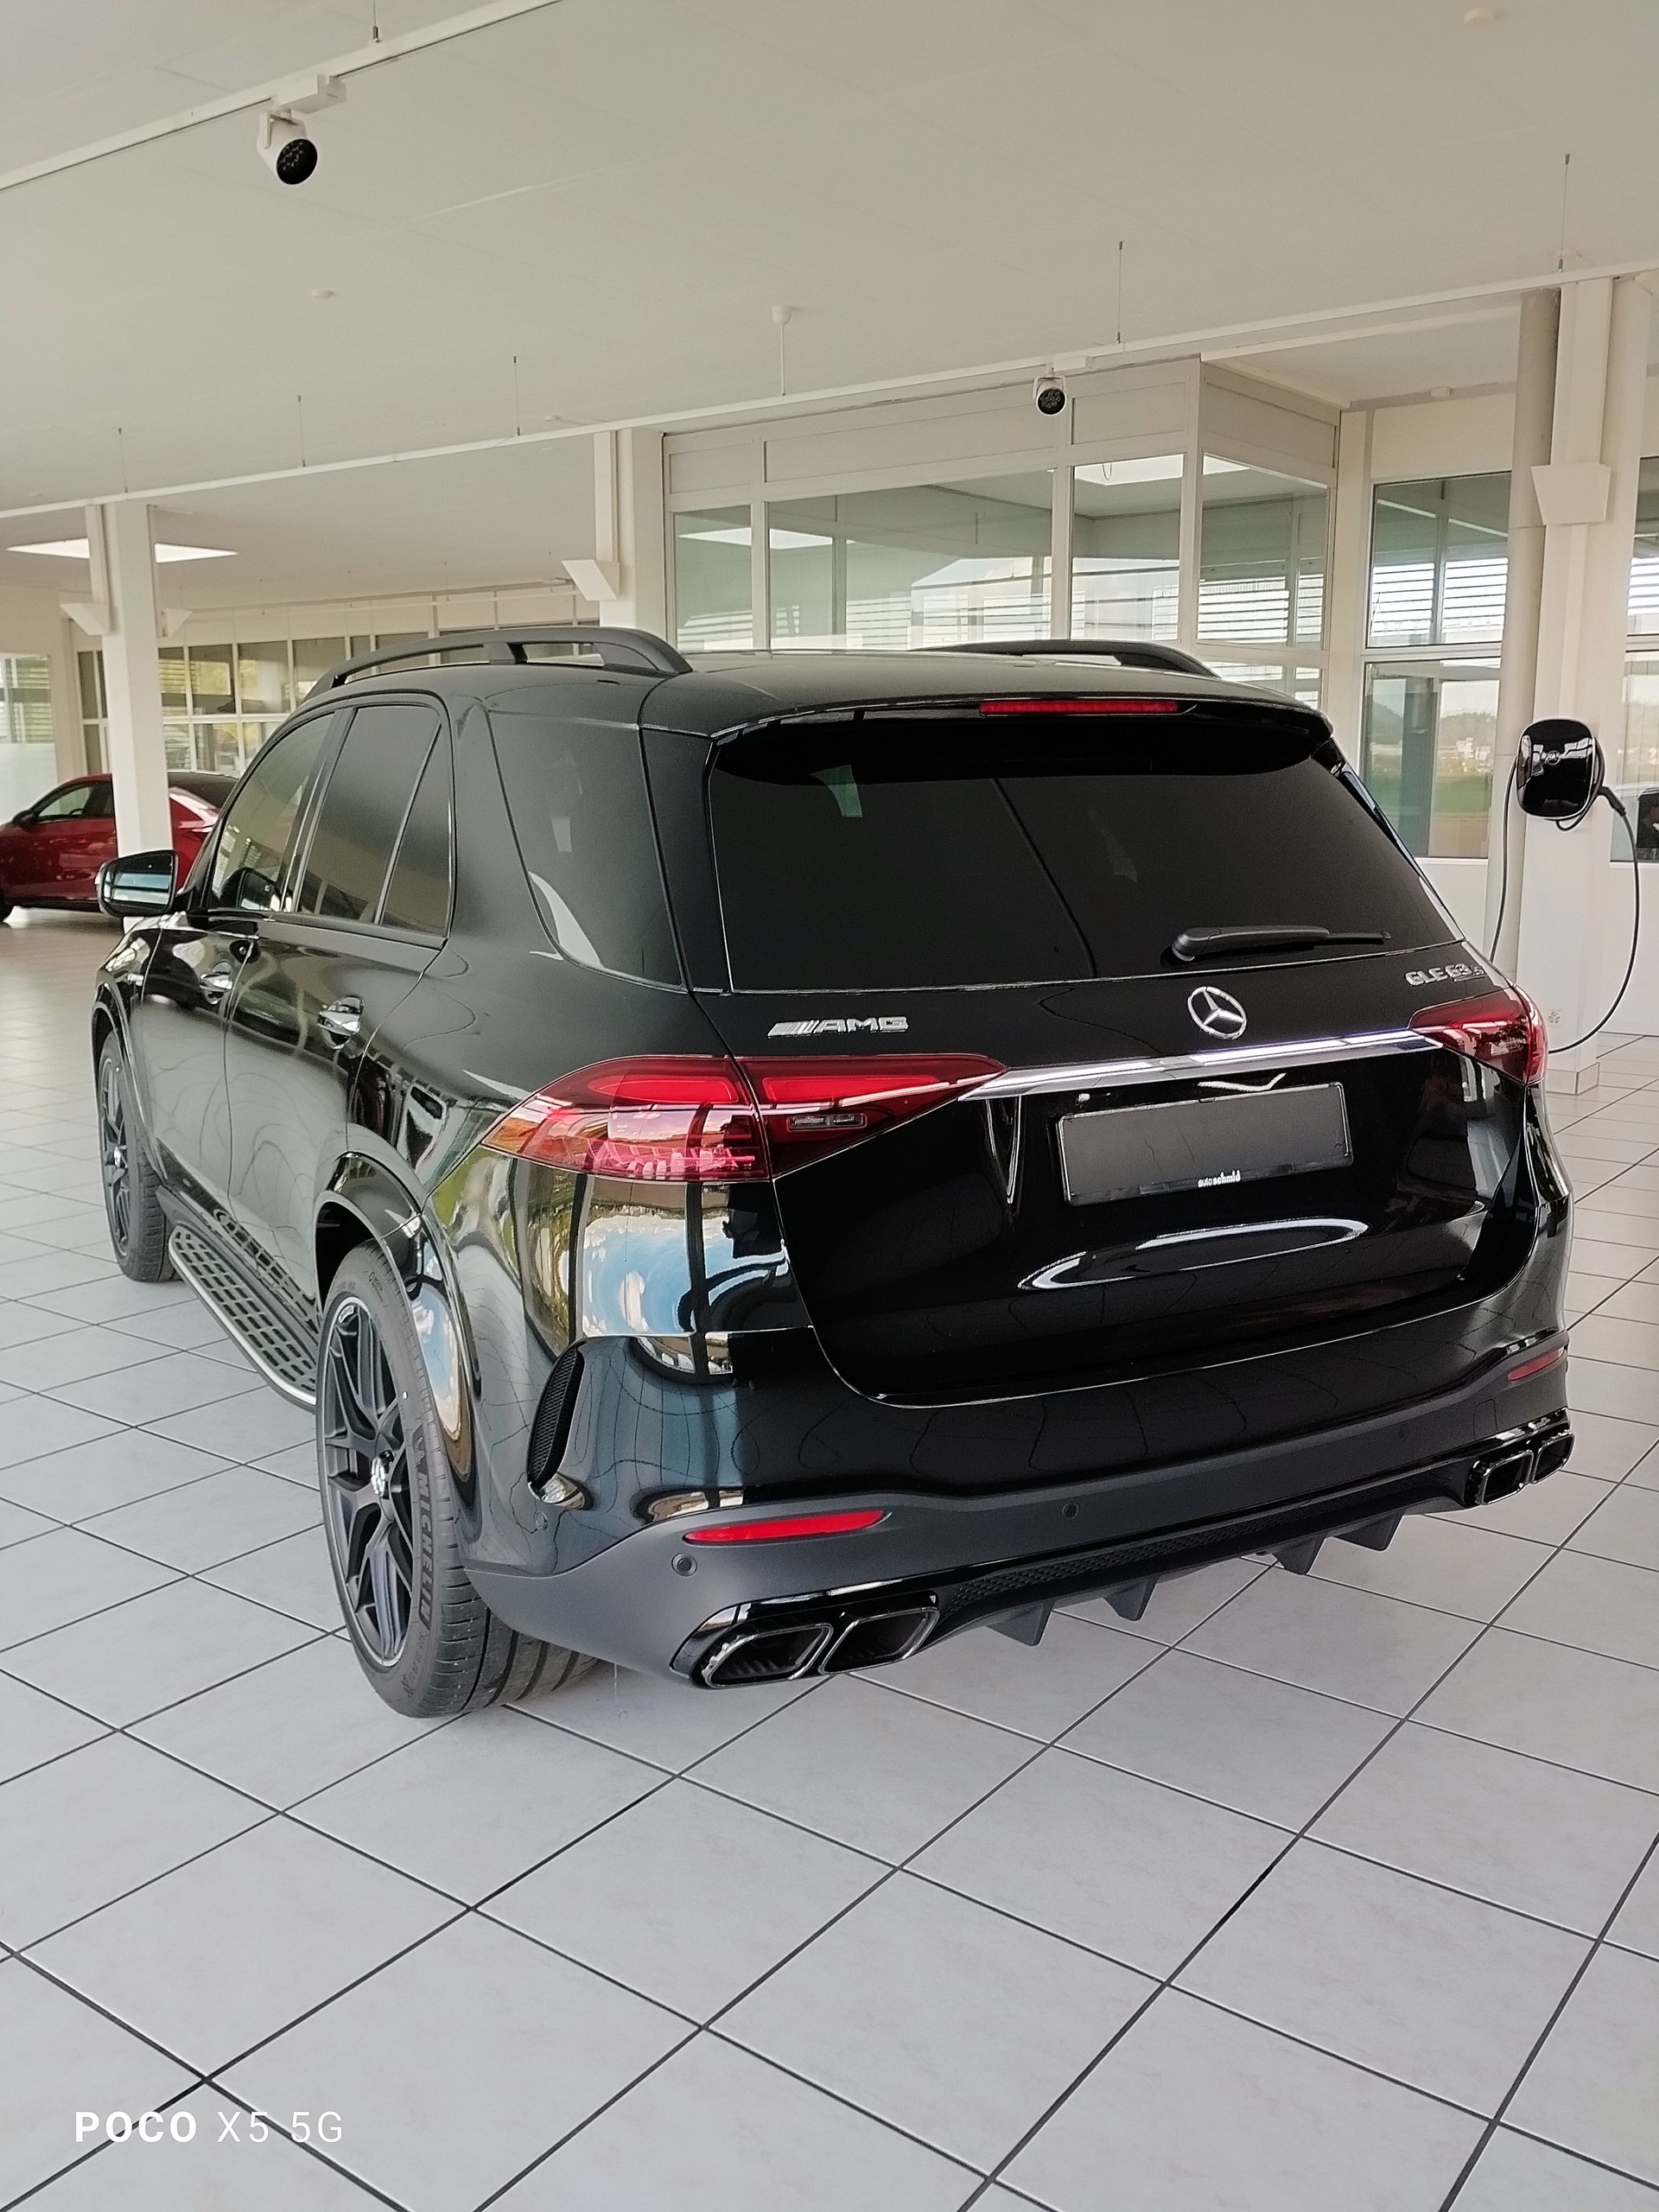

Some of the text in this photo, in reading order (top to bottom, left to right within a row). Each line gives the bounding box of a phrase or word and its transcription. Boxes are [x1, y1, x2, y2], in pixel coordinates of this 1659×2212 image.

[1405, 967, 1448, 986] GLE
[814, 1016, 908, 1033] AMG
[417, 1472, 432, 1621] MICHELIN
